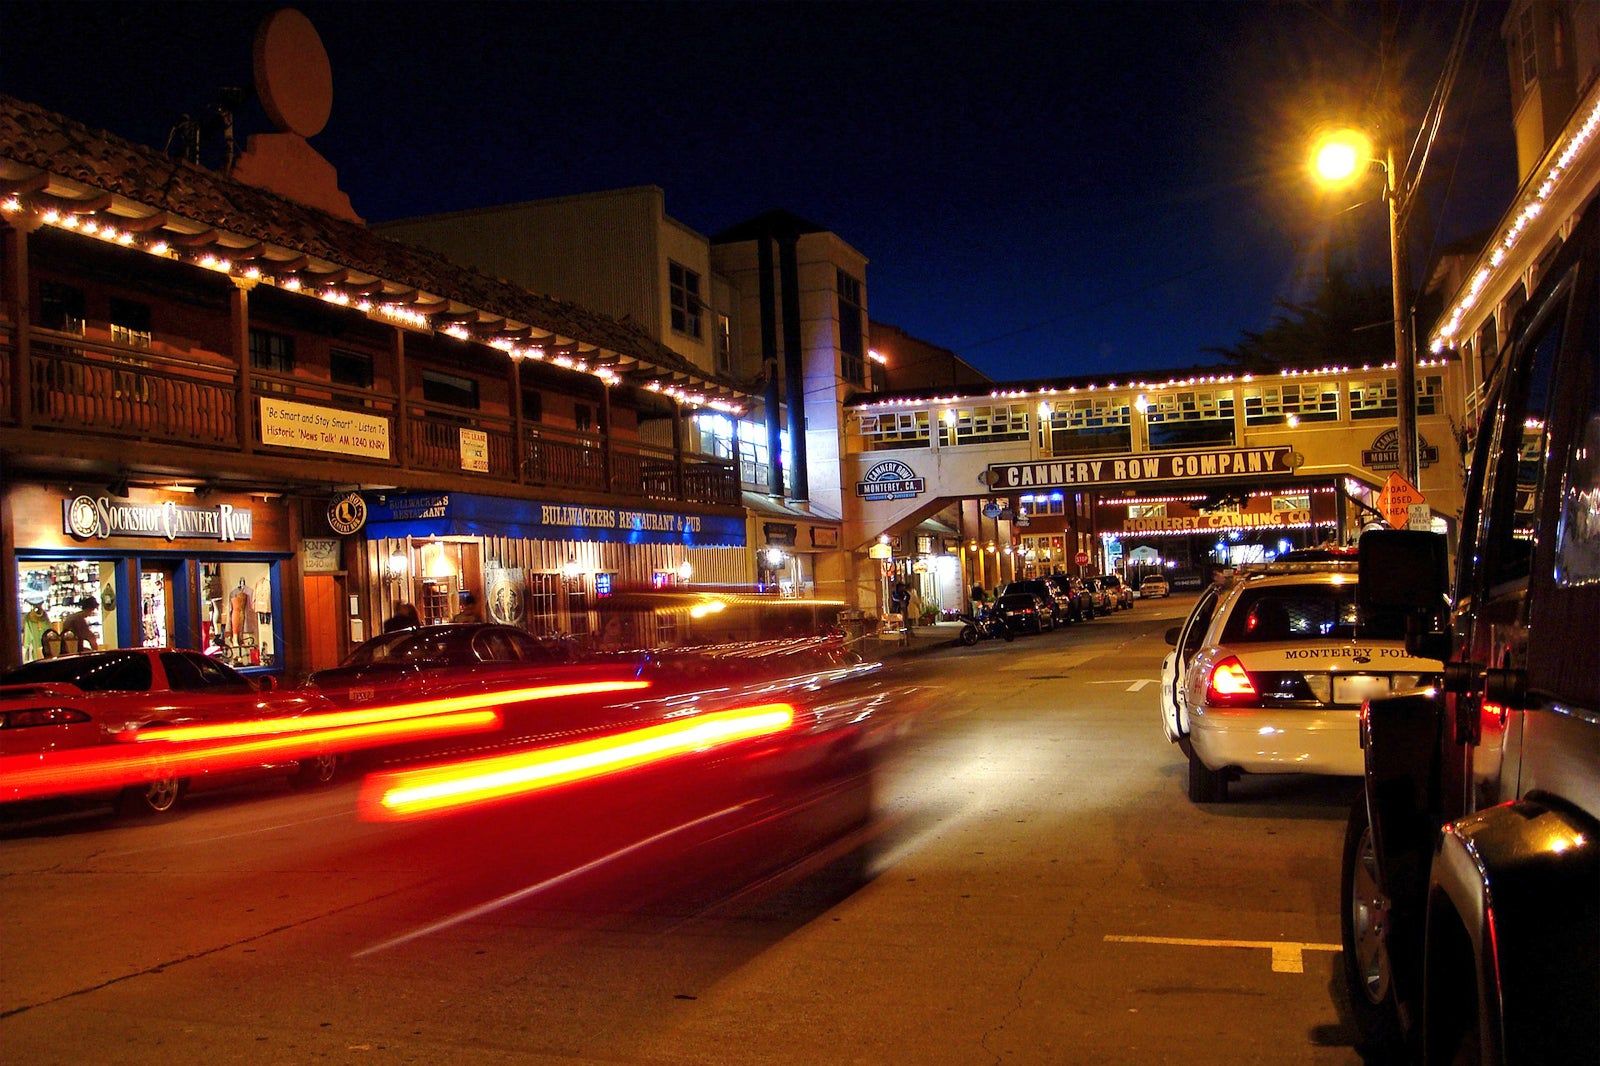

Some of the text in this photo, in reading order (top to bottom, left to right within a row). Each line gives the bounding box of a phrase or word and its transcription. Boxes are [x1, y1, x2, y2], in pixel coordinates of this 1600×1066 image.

[266, 406, 278, 418] "Be
[280, 409, 301, 421] Smart
[302, 413, 314, 424] and
[315, 415, 331, 428] Stay
[332, 418, 353, 429] Smart"
[359, 423, 376, 434] Listen
[378, 425, 385, 435] To
[266, 424, 385, 451] Historic 'News Talk' AM 1240 KNRY
[1377, 430, 1399, 449] CANNE
[1371, 452, 1399, 462] MONTE
[868, 462, 911, 481] CANNERY ROW
[1007, 451, 1276, 487] CANNERY ROW COMPANY
[863, 481, 917, 493] MONTEREY, CA.
[1384, 495, 1413, 505] COSED
[97, 497, 251, 541] SOCKSHOP CANNERY ROW
[541, 505, 701, 533] BULLWACKERS RESTAURANT & PUB
[1123, 510, 1311, 531] MONTEREY CANNING CO
[303, 540, 336, 554] KNRY
[1285, 649, 1416, 660] MONTEREY POL
